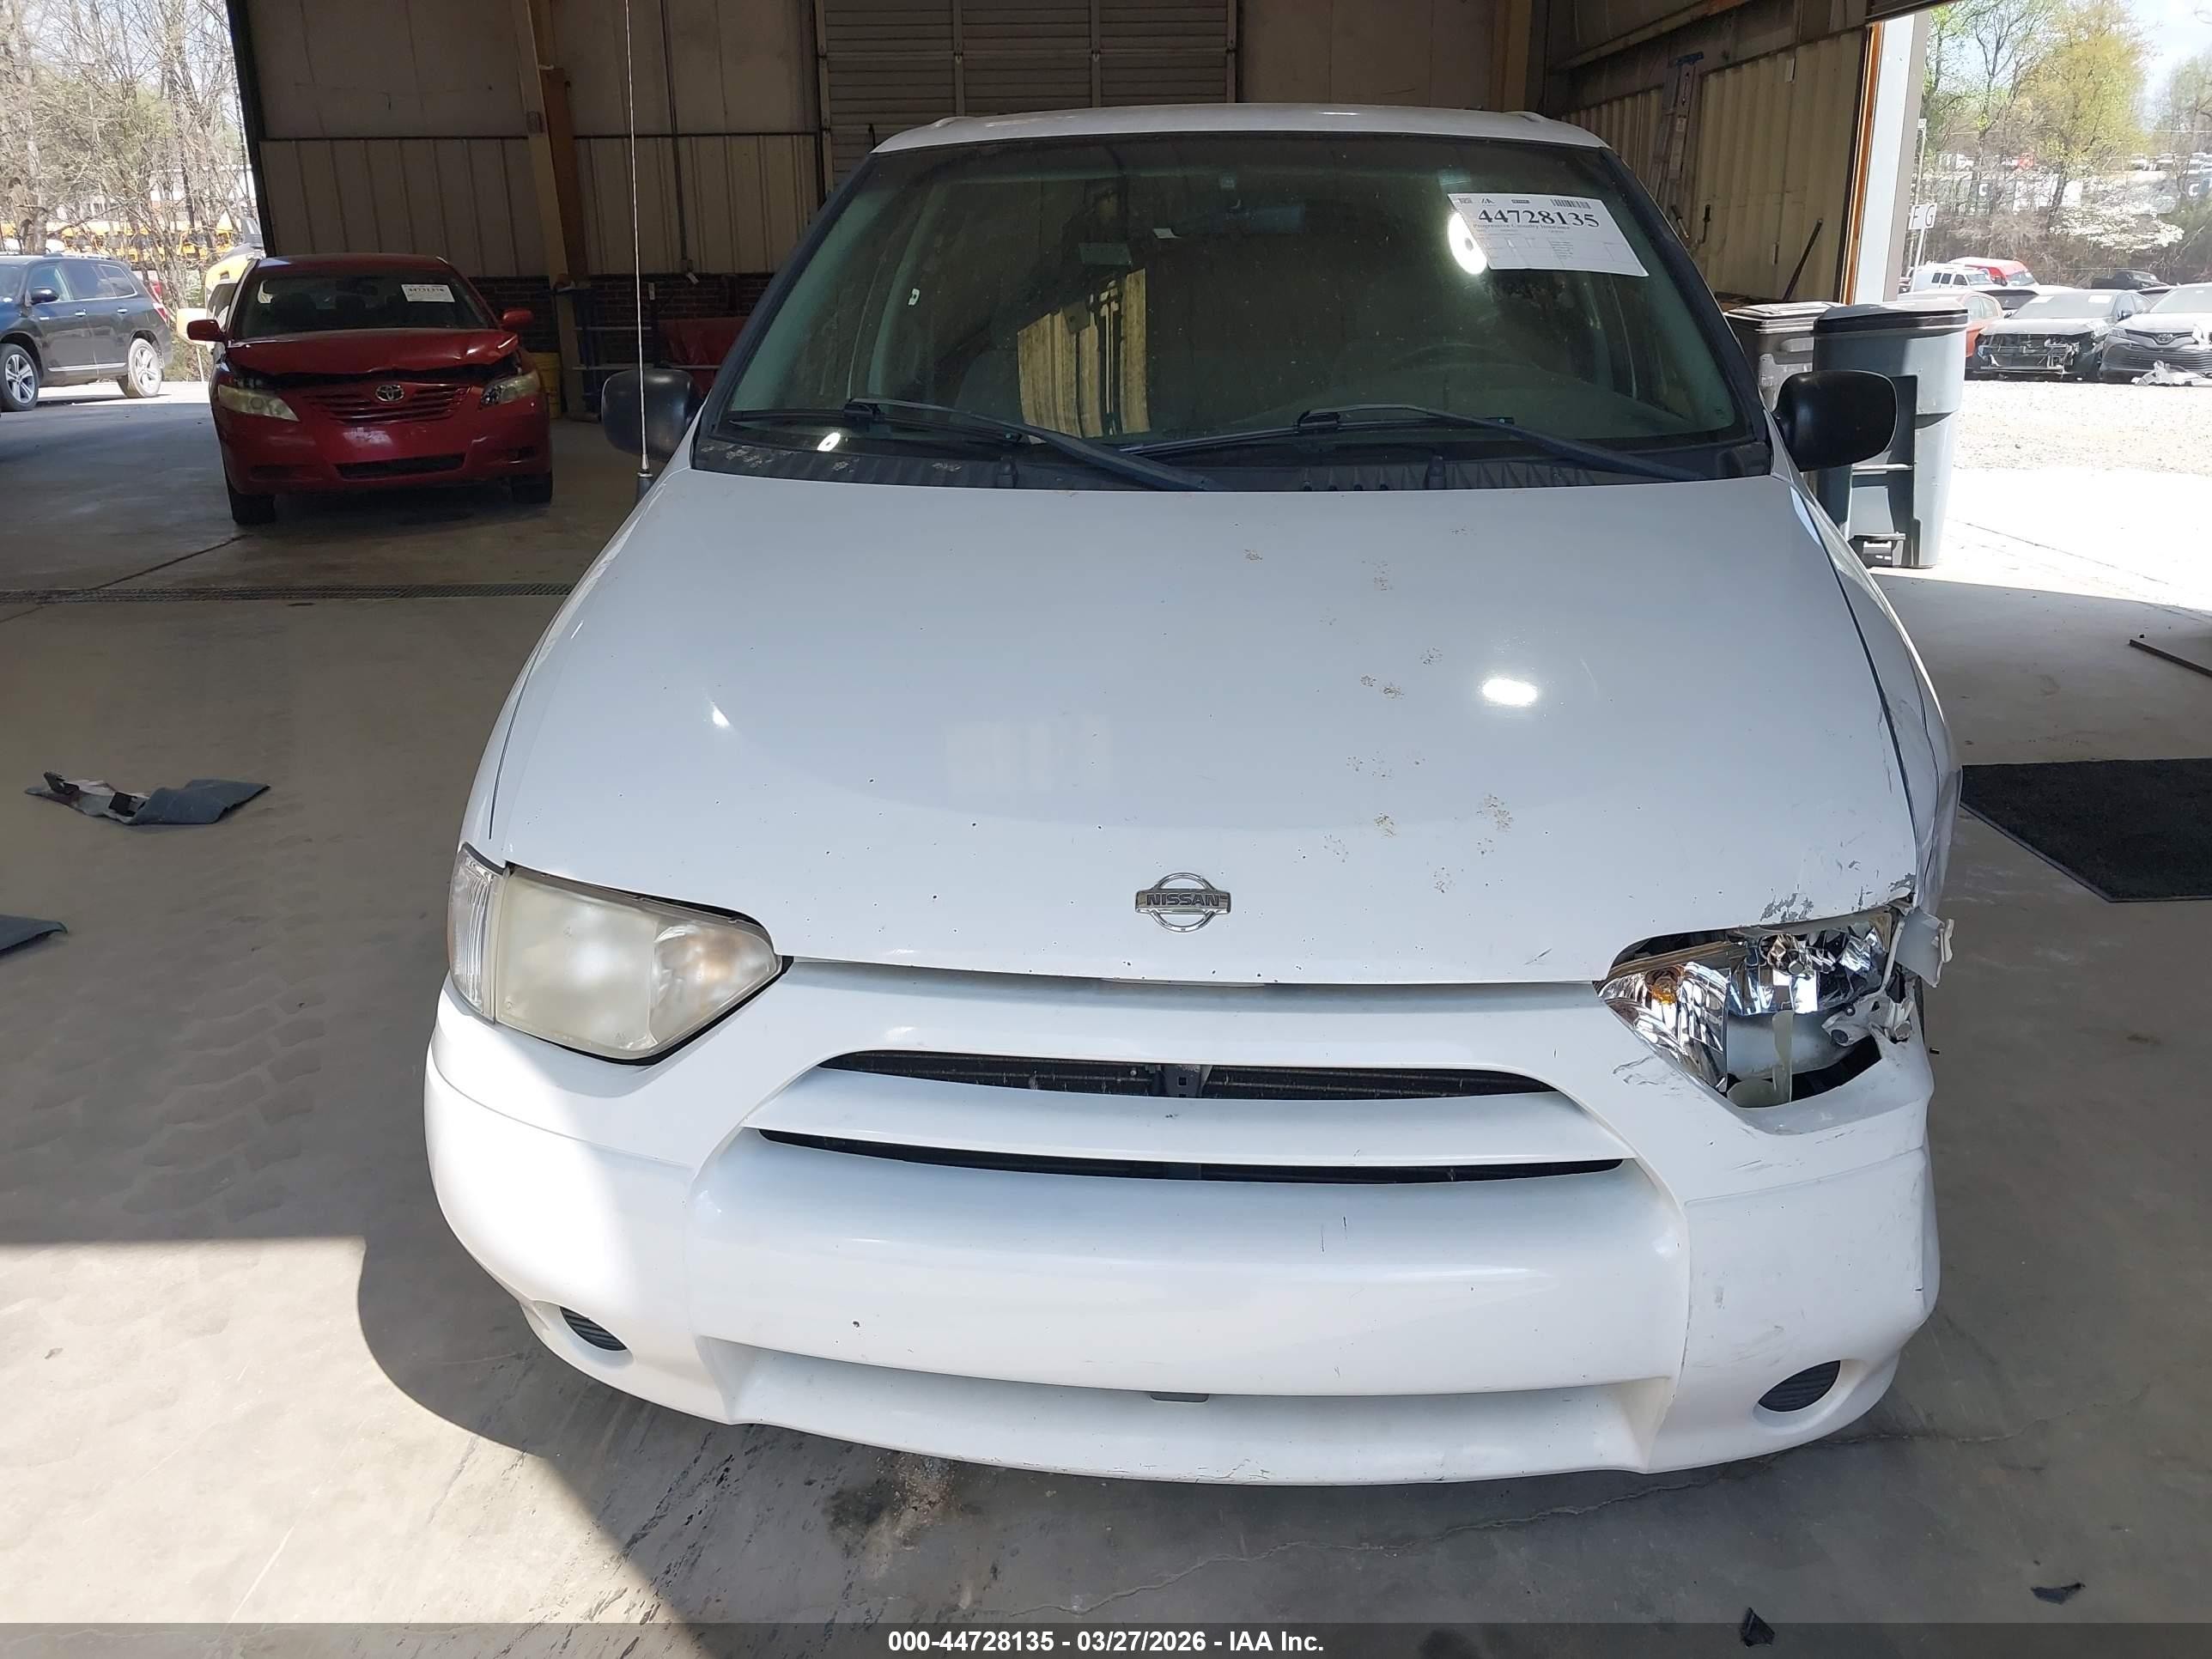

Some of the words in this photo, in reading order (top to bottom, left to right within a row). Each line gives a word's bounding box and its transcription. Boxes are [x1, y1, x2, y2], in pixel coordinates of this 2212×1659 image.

[1478, 210, 1600, 228] 44728135
[1911, 206, 1920, 228] F
[1925, 204, 1935, 227] G
[1146, 893, 1219, 907] NISSAN
